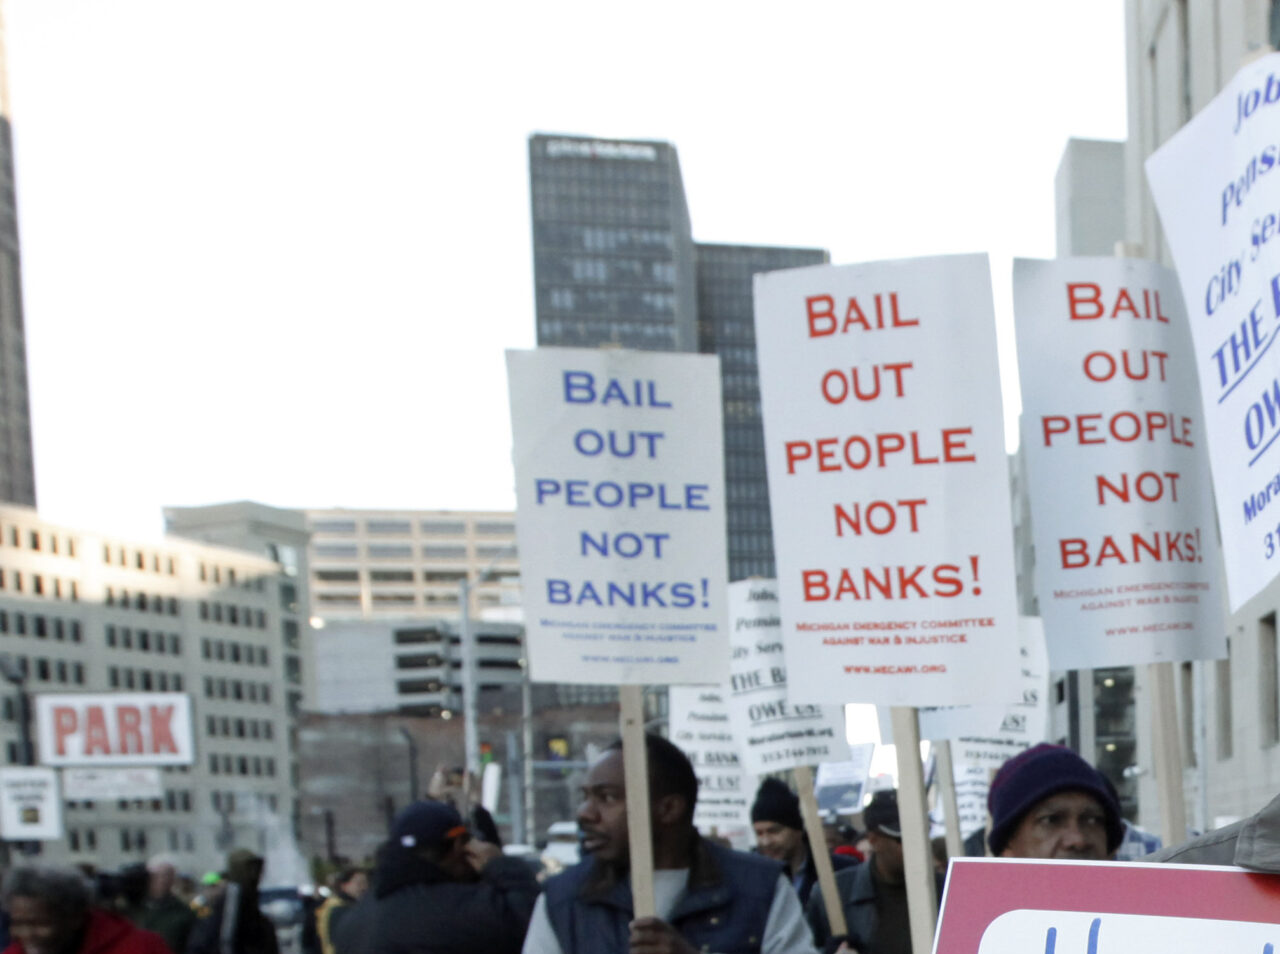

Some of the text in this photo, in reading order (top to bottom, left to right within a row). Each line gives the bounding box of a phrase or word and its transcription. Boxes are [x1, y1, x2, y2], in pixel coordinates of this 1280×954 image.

[1065, 281, 1170, 324] BAIL
[1205, 252, 1245, 316] City
[805, 292, 920, 339] BAIL
[1211, 298, 1269, 389] THE
[821, 361, 914, 405] OUT
[1082, 349, 1169, 383] OUT
[562, 370, 673, 409] BAIL
[573, 428, 665, 460] OUT
[1041, 411, 1195, 448] PEOPLE
[784, 426, 976, 474] PEOPLE
[535, 478, 711, 511] PEOPLE
[1095, 470, 1181, 506] NOT
[833, 498, 927, 538] NOT
[579, 530, 671, 560] NOT
[1059, 527, 1203, 571] BANKS!
[546, 577, 710, 609] BANKS!
[801, 555, 982, 602] BANKS!
[52, 704, 179, 756] PARK
[748, 699, 788, 722] OWE
